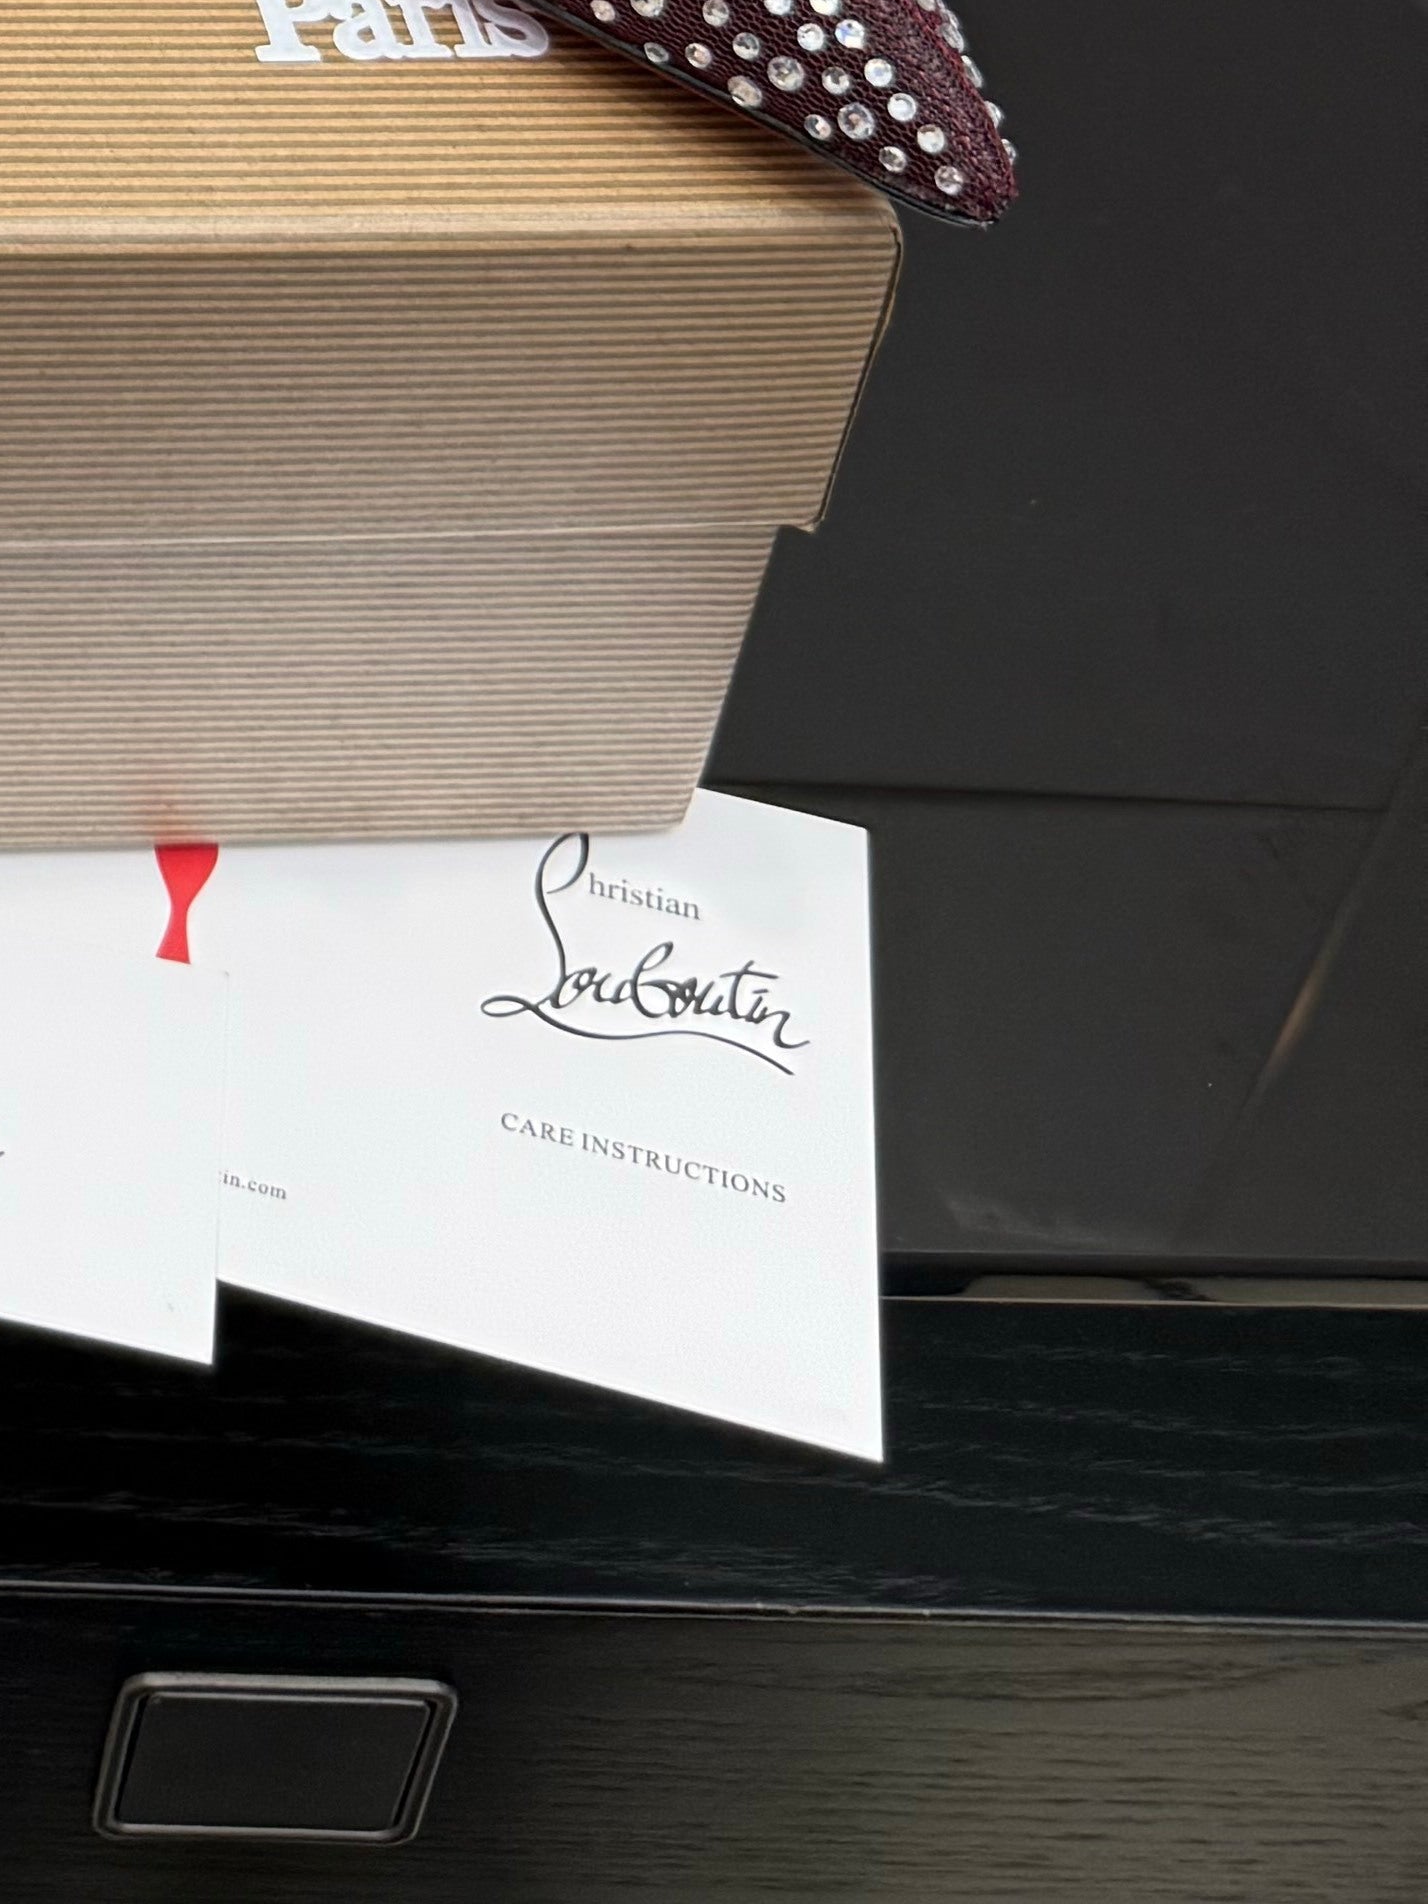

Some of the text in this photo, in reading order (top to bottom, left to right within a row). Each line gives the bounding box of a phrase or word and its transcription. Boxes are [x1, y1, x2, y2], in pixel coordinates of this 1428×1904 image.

[481, 882, 810, 1075] Louboutin
[500, 1112, 787, 1204] CARE INSTRUCTIONS
